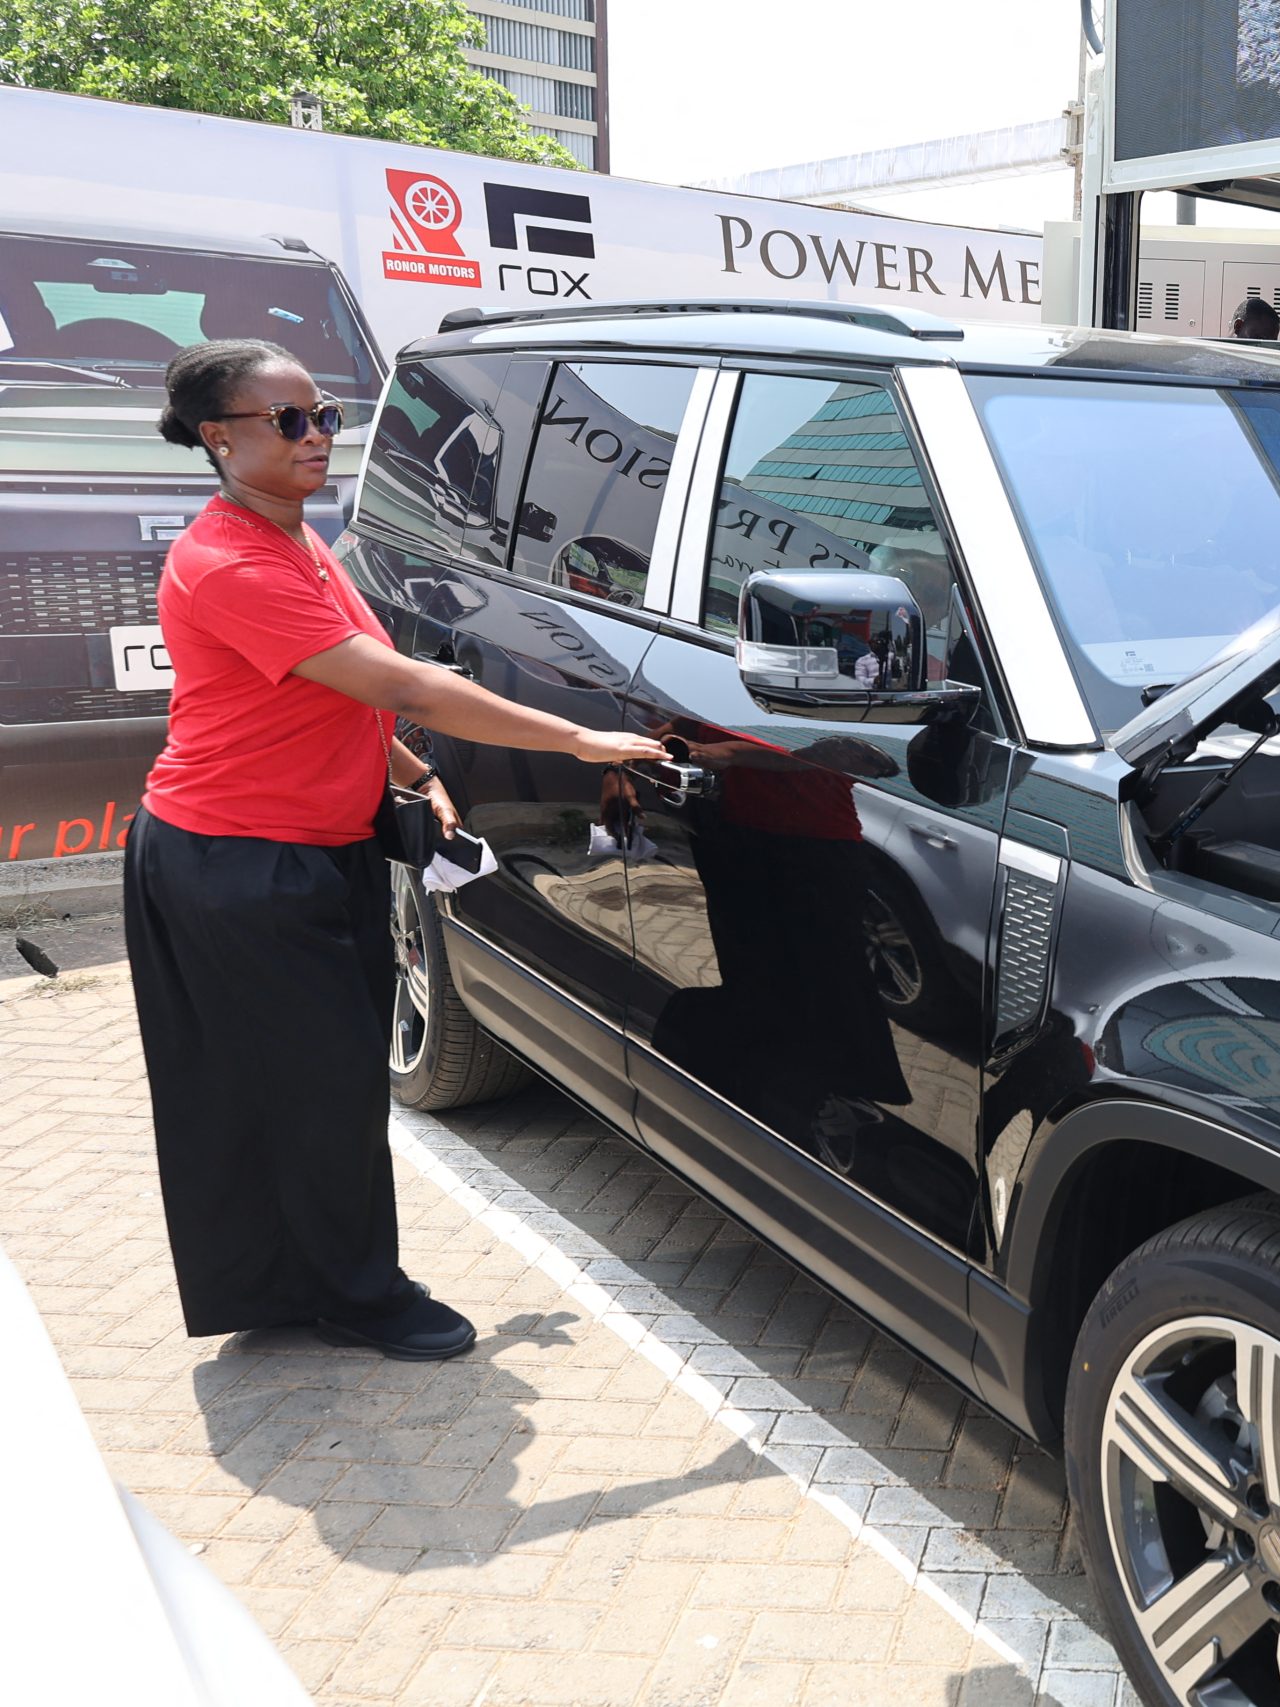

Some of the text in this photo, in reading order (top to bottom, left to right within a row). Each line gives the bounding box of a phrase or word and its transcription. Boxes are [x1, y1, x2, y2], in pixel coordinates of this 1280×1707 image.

[386, 259, 476, 279] RONOR MOTORS
[715, 213, 946, 296] POWER
